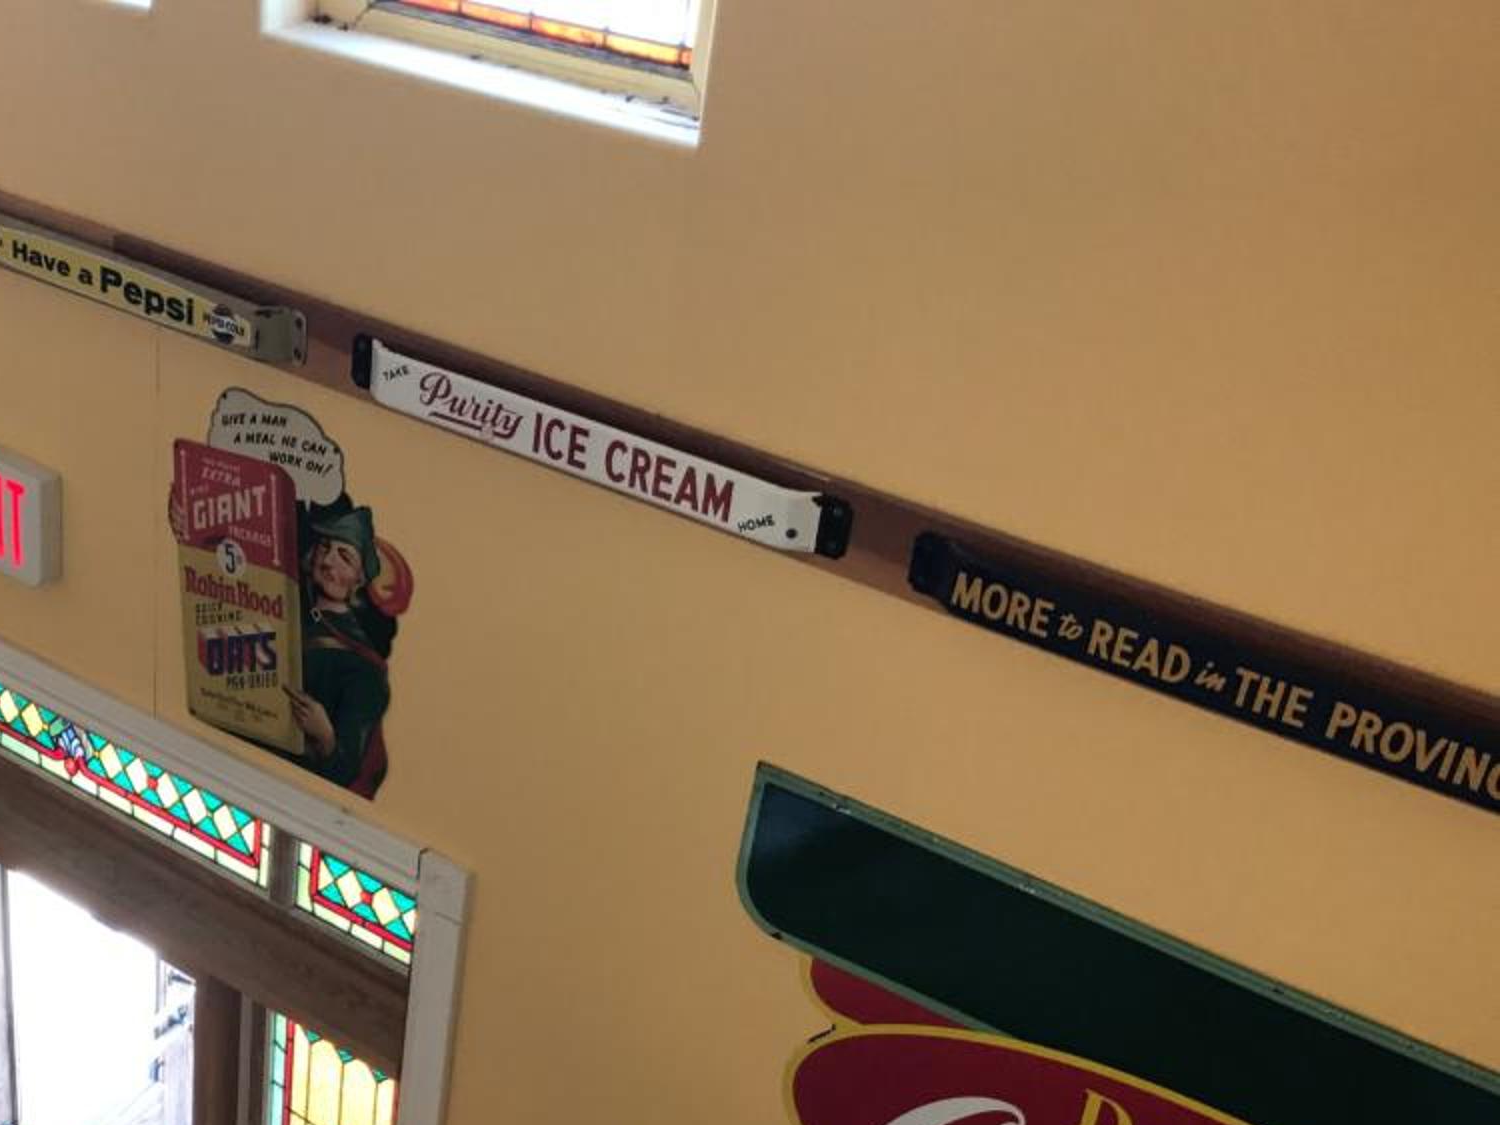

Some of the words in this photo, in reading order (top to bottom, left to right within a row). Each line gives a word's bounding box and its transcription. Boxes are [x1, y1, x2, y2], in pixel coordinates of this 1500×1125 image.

[11, 238, 70, 277] Have
[77, 267, 94, 286] a
[99, 266, 196, 327] Pepsi
[222, 413, 246, 427] GIVE
[250, 414, 258, 424] A
[261, 414, 287, 427] MAN
[233, 433, 242, 445] A
[245, 432, 276, 447] MEAL
[282, 435, 297, 449] HE
[301, 440, 328, 456] CAN
[268, 451, 303, 468] WORK
[305, 460, 334, 478] ON!
[382, 363, 409, 382] TAKE
[418, 370, 524, 440] Purity
[531, 411, 591, 470] ICE
[605, 439, 735, 524] CREAM
[737, 515, 776, 534] HOME
[201, 468, 242, 489] EXTRA
[193, 485, 267, 530] GIANT
[184, 565, 237, 602] Robin
[236, 580, 284, 620] Hood
[198, 630, 277, 677] OATS
[950, 572, 1055, 637] MORE
[1058, 608, 1083, 641] to
[1086, 620, 1192, 685] READ
[1194, 661, 1227, 692] in
[1235, 667, 1314, 729] THE
